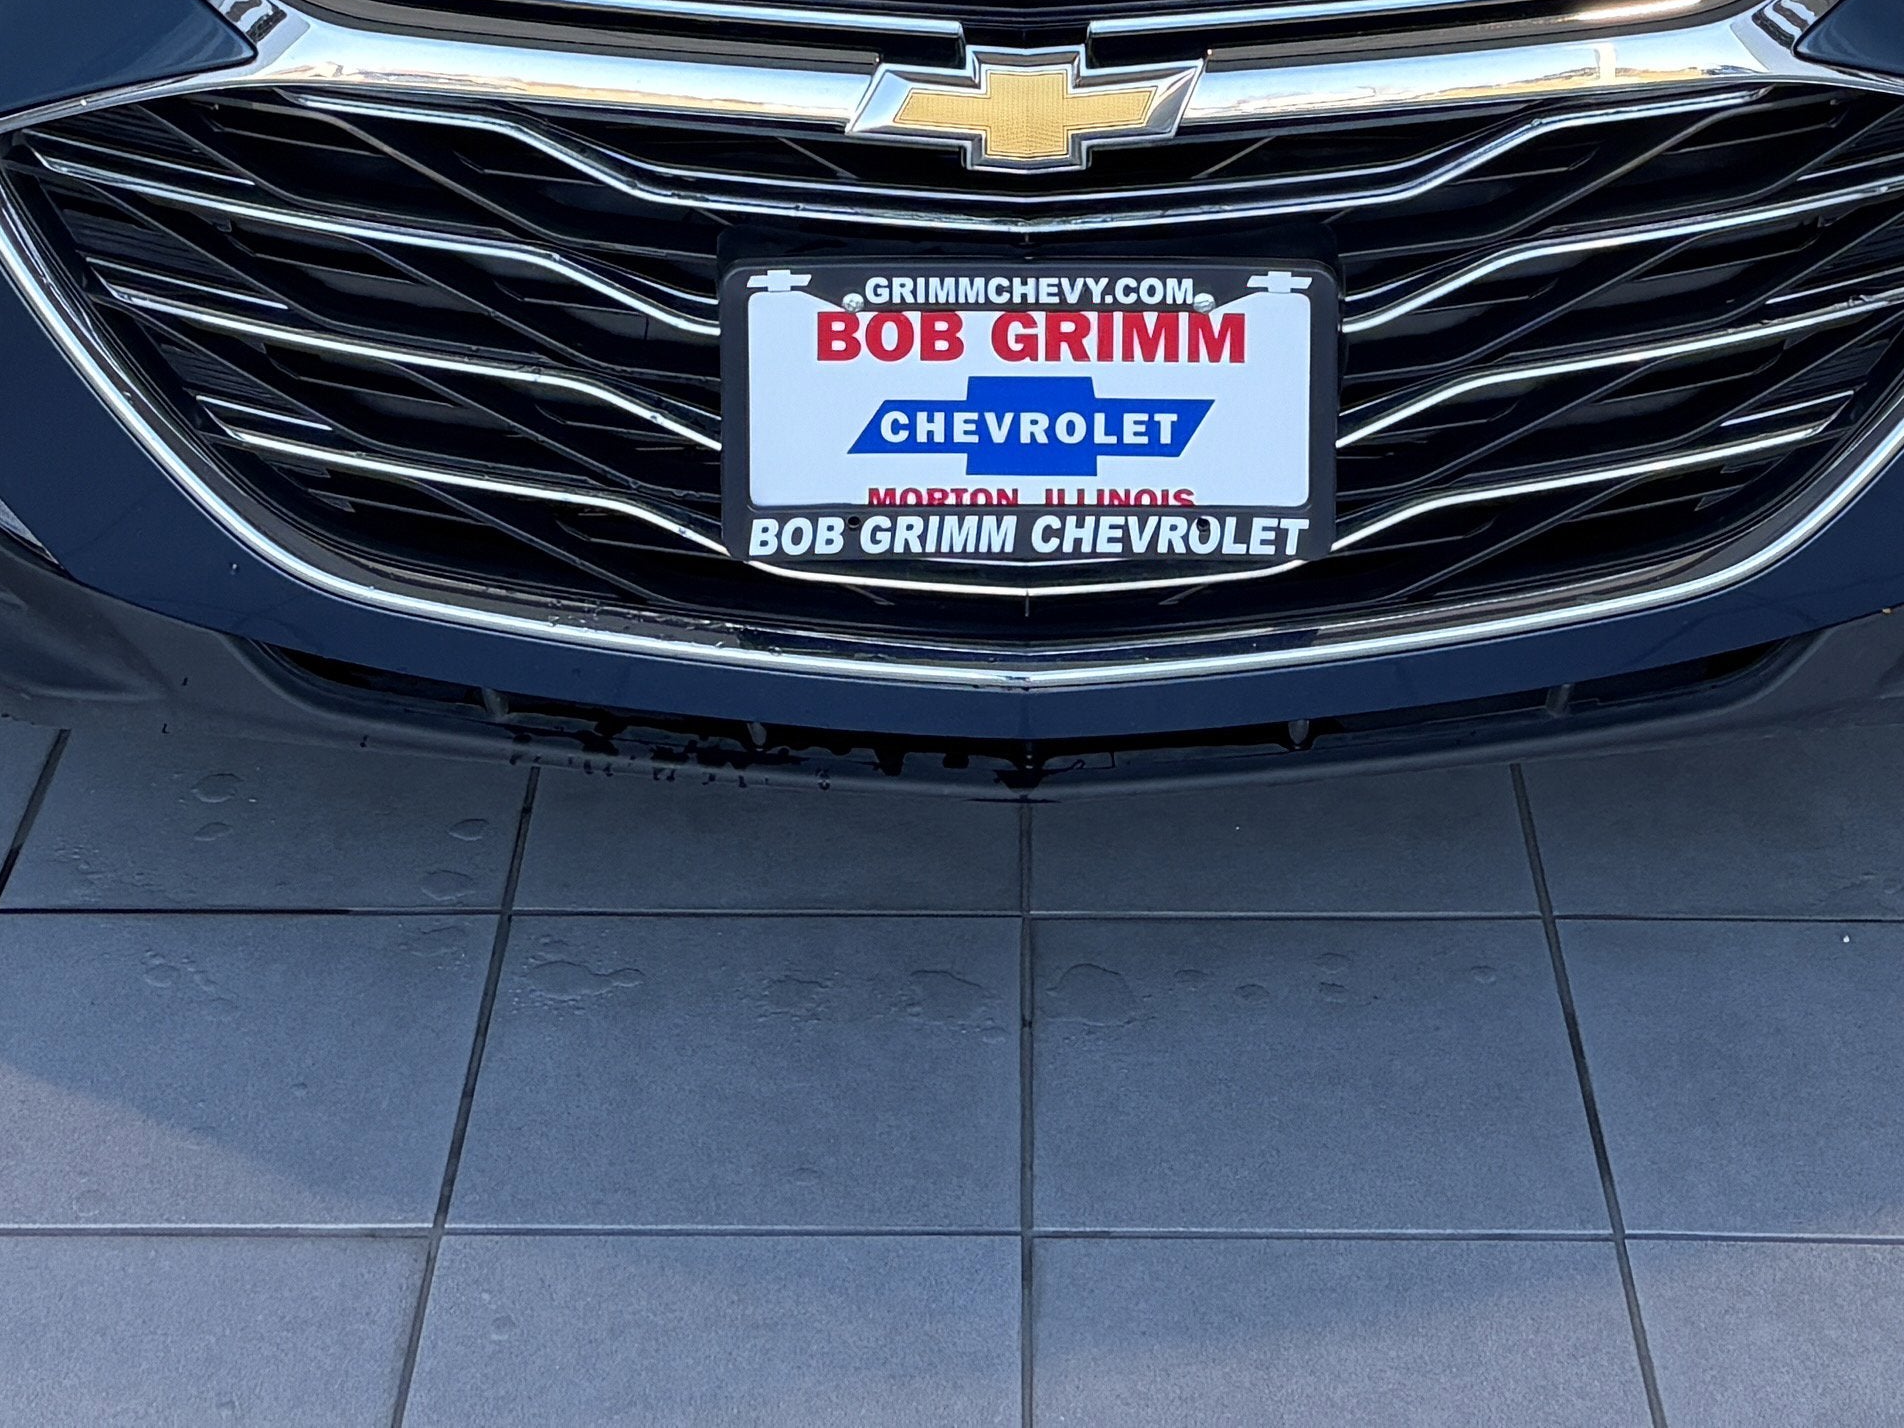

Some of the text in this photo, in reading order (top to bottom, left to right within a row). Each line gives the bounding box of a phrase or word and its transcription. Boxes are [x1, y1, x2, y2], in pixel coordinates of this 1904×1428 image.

[865, 275, 1194, 306] GRIMMCHEVY.COM
[816, 311, 1247, 365] BOB GRIMM
[880, 410, 1179, 445] CHEVROLET
[748, 514, 1310, 556] BOB GRIMM CHEVROLET
